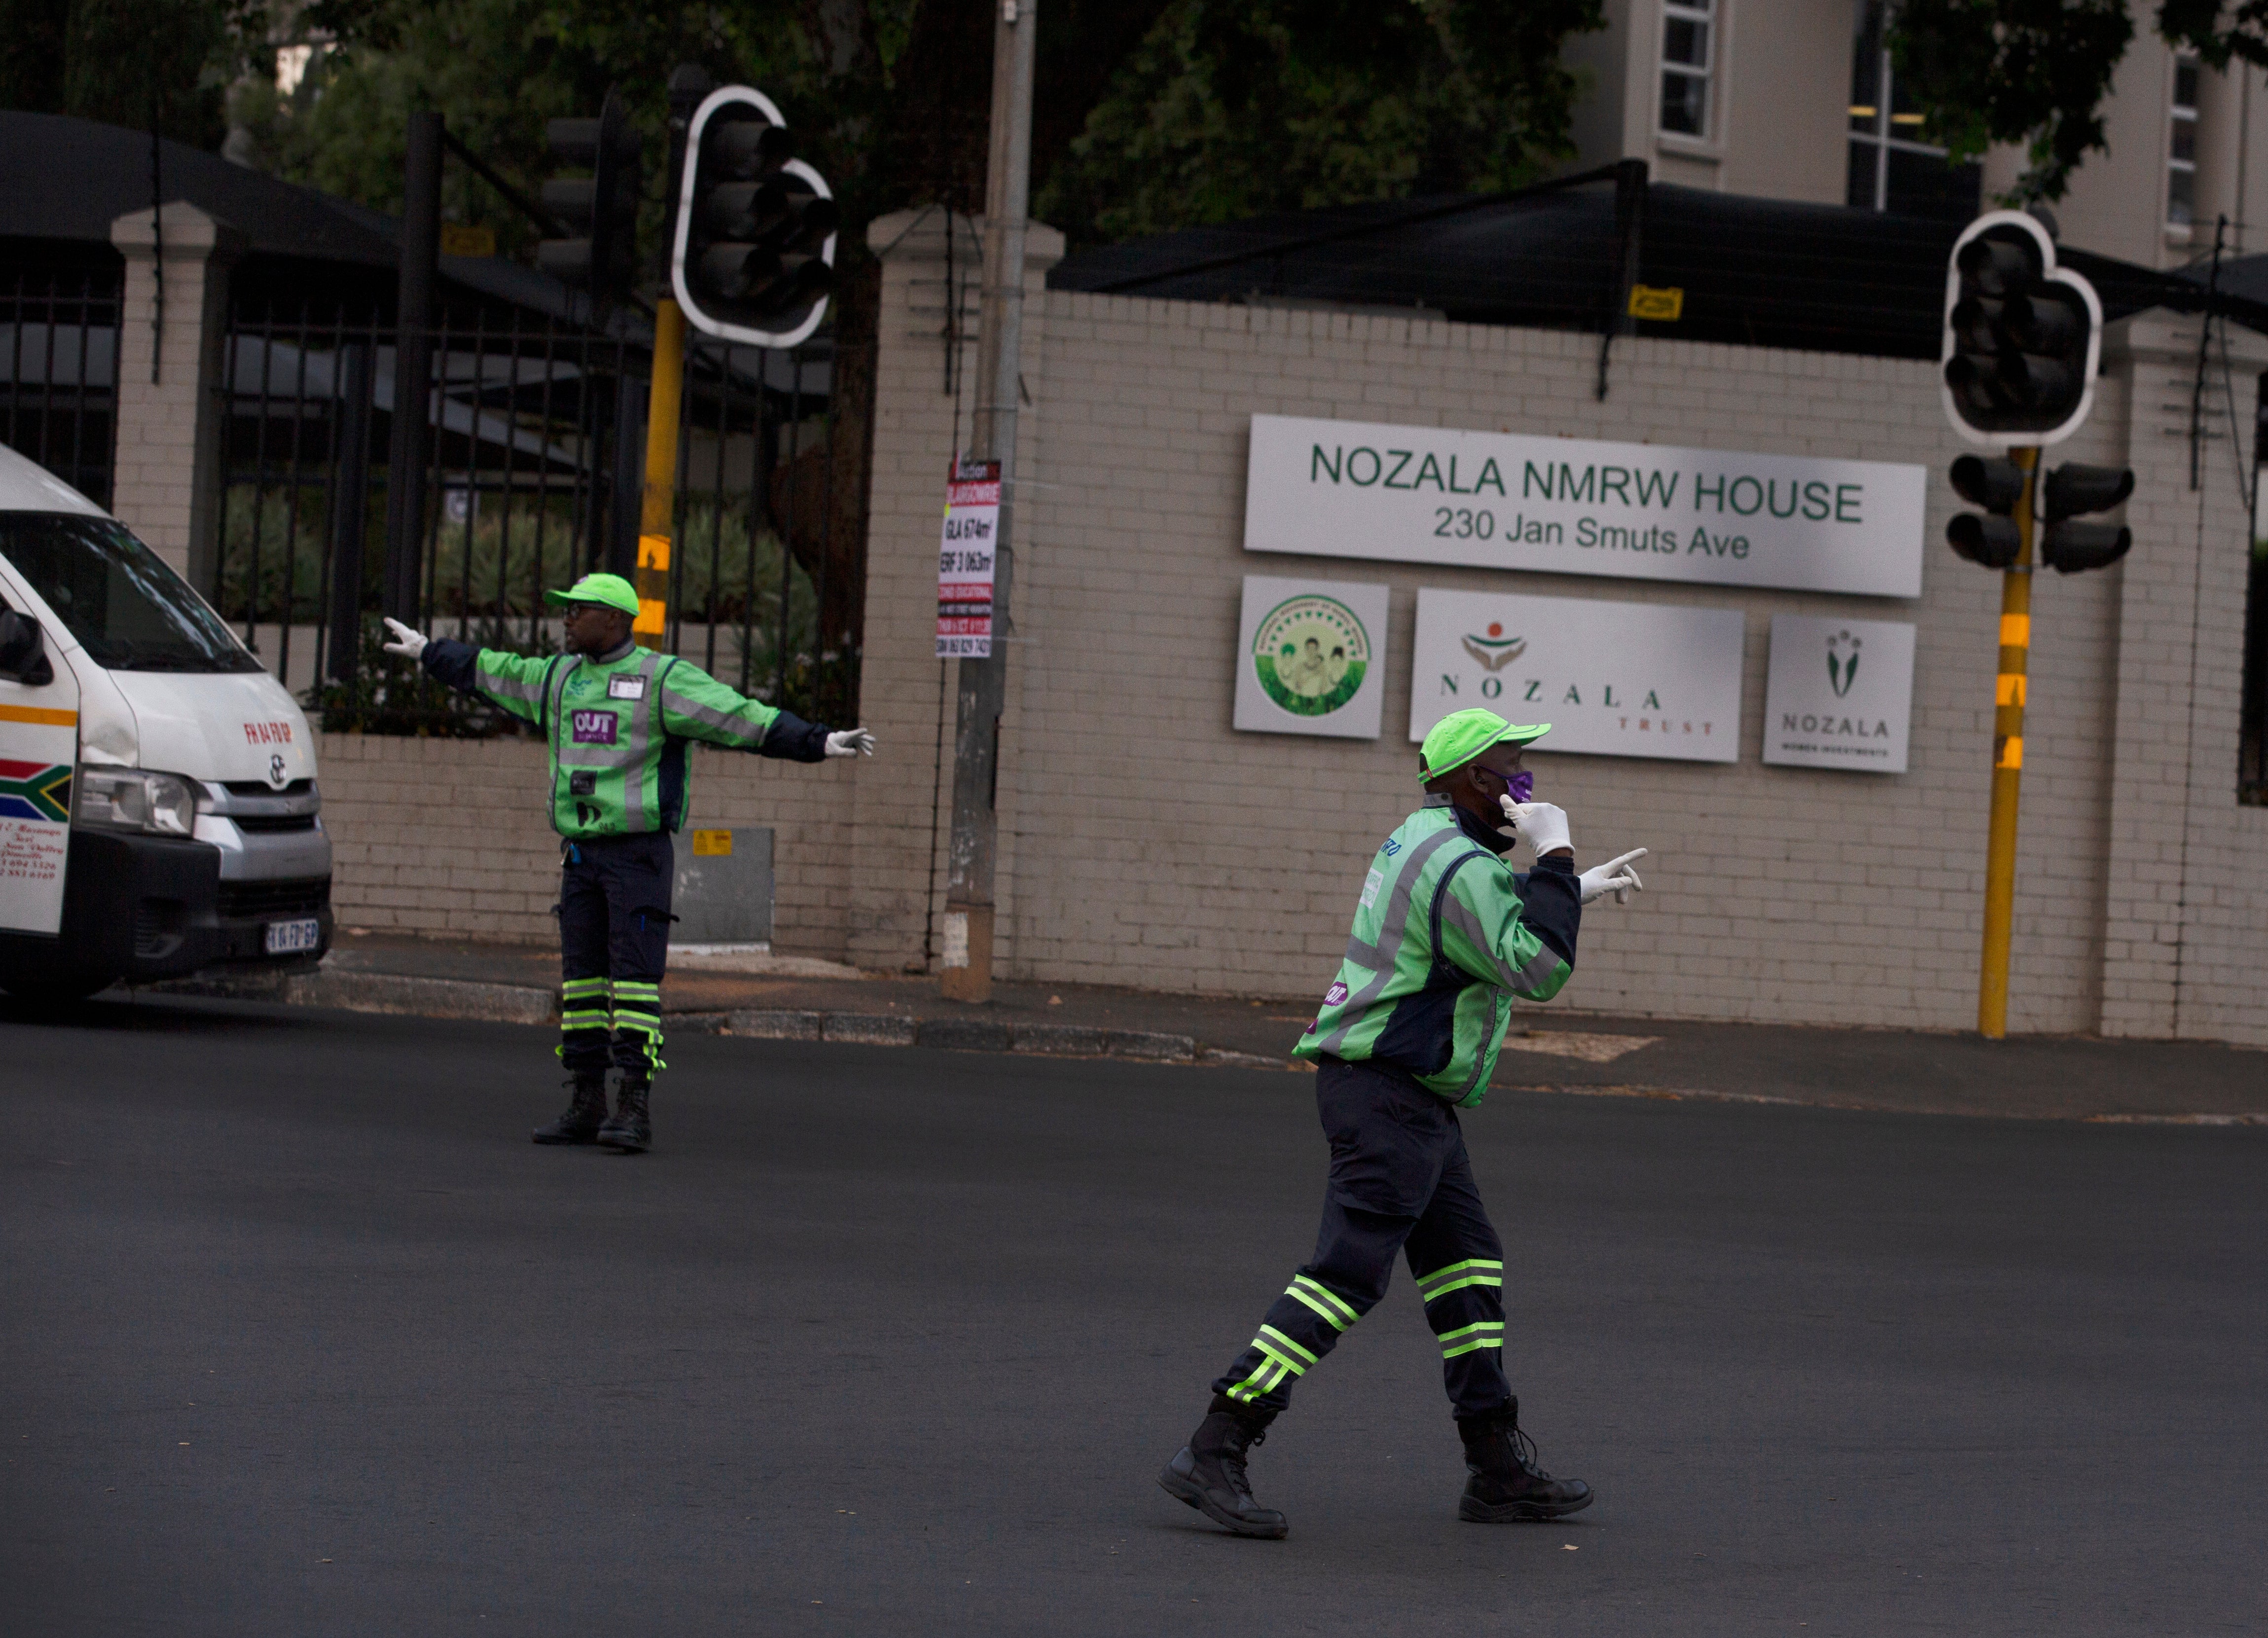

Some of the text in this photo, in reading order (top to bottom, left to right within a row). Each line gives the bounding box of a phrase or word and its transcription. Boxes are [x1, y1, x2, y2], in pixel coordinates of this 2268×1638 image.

[1311, 443, 1863, 523] NOZALA NMRW HOUSE
[1434, 507, 1750, 559] 230 Jan Smuts Ave
[1440, 673, 1661, 710] NOZALA
[574, 712, 613, 733] OUT
[1619, 717, 1713, 736] TRUST
[1782, 713, 1889, 738] NOZALA
[1325, 985, 1347, 1003] OUT
